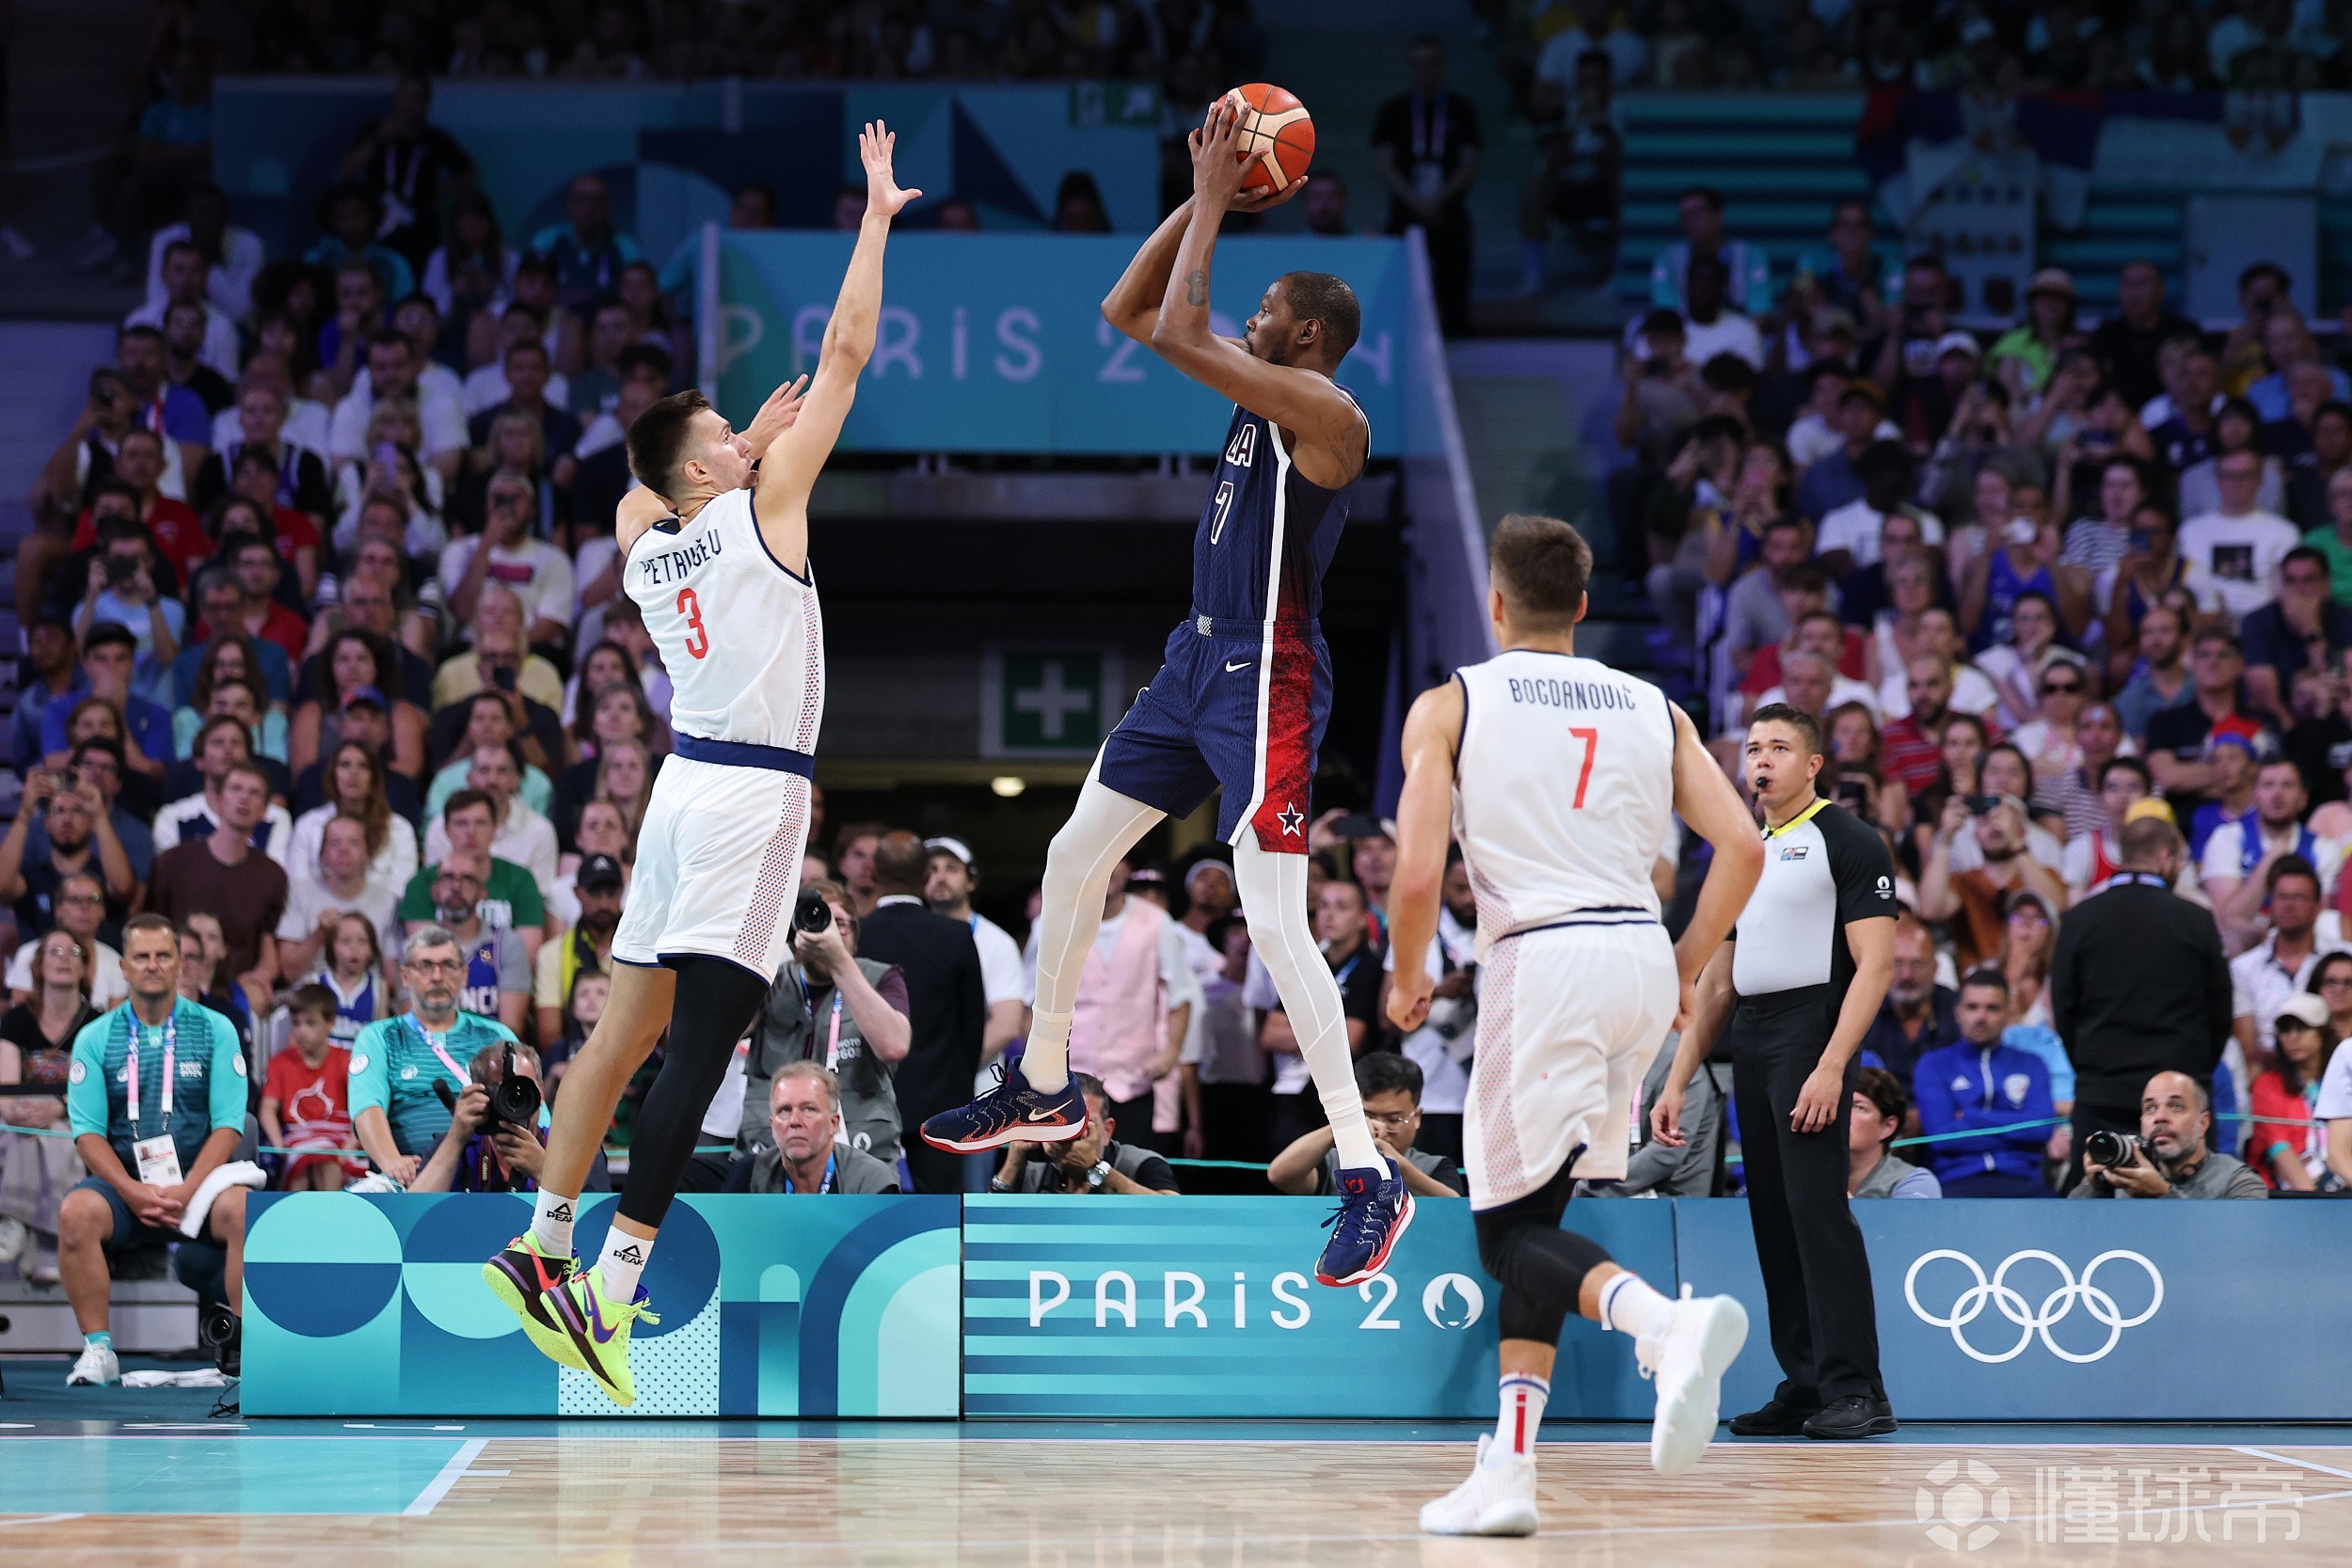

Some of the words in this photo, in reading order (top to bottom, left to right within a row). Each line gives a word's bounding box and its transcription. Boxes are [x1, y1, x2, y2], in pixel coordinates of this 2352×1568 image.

[1211, 481, 1234, 546] 7
[676, 588, 708, 659] 3
[1567, 727, 1597, 810] 7
[547, 1210, 575, 1224] PEAK
[612, 1249, 644, 1266] PEAK
